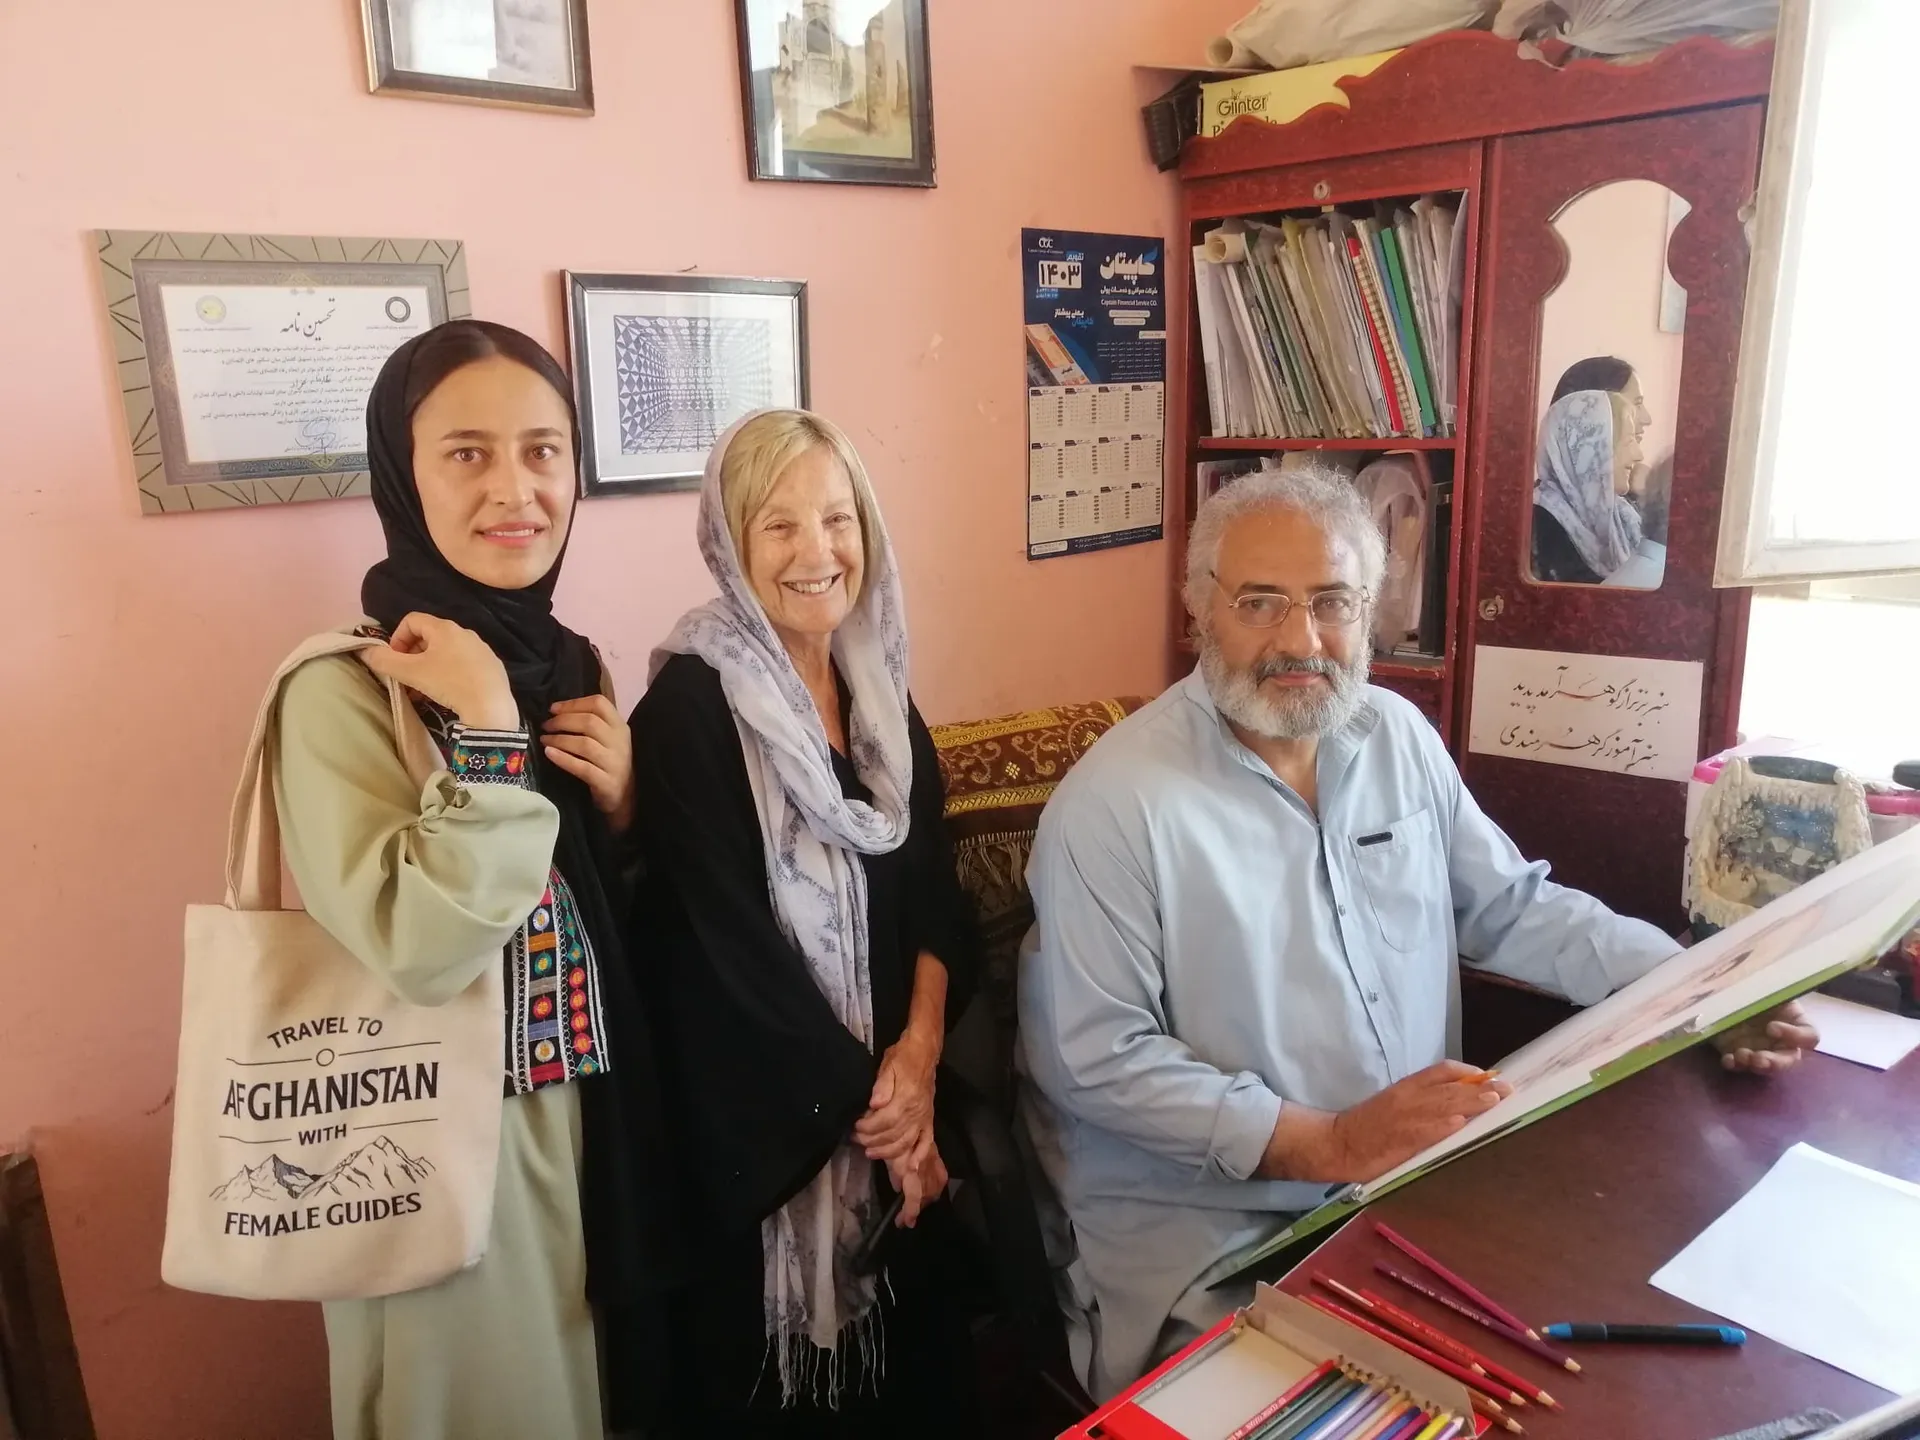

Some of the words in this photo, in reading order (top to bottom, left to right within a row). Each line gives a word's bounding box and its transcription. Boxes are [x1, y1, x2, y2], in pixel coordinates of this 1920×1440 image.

[1040, 263, 1080, 286] ۱۴۰۳
[1100, 247, 1157, 286] کاپیتان
[280, 311, 301, 333] نامه
[303, 297, 336, 341] تحسین
[266, 1016, 349, 1049] TRAVEL
[357, 1016, 383, 1037] TO
[222, 1061, 440, 1121] AFGHANISTAN
[297, 1123, 348, 1146] WITH
[223, 1206, 321, 1237] FEMALE
[325, 1191, 422, 1227] GUIDES
